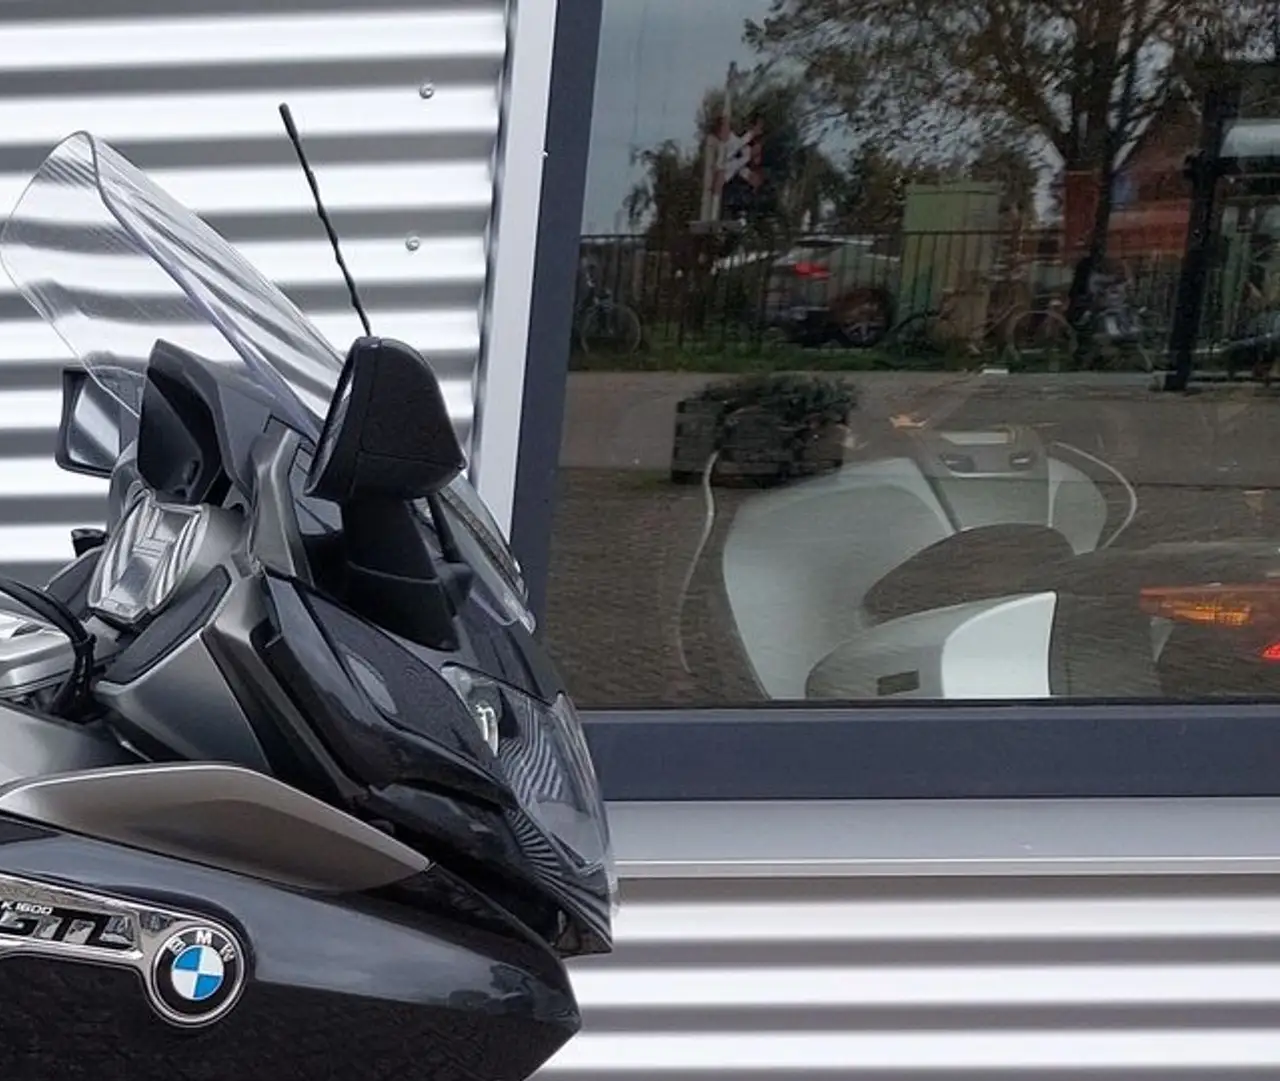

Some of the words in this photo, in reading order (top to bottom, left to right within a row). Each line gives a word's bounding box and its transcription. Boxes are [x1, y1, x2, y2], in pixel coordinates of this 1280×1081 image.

[0, 900, 13, 911] K
[15, 902, 54, 916] 1600
[170, 931, 236, 963] BMW
